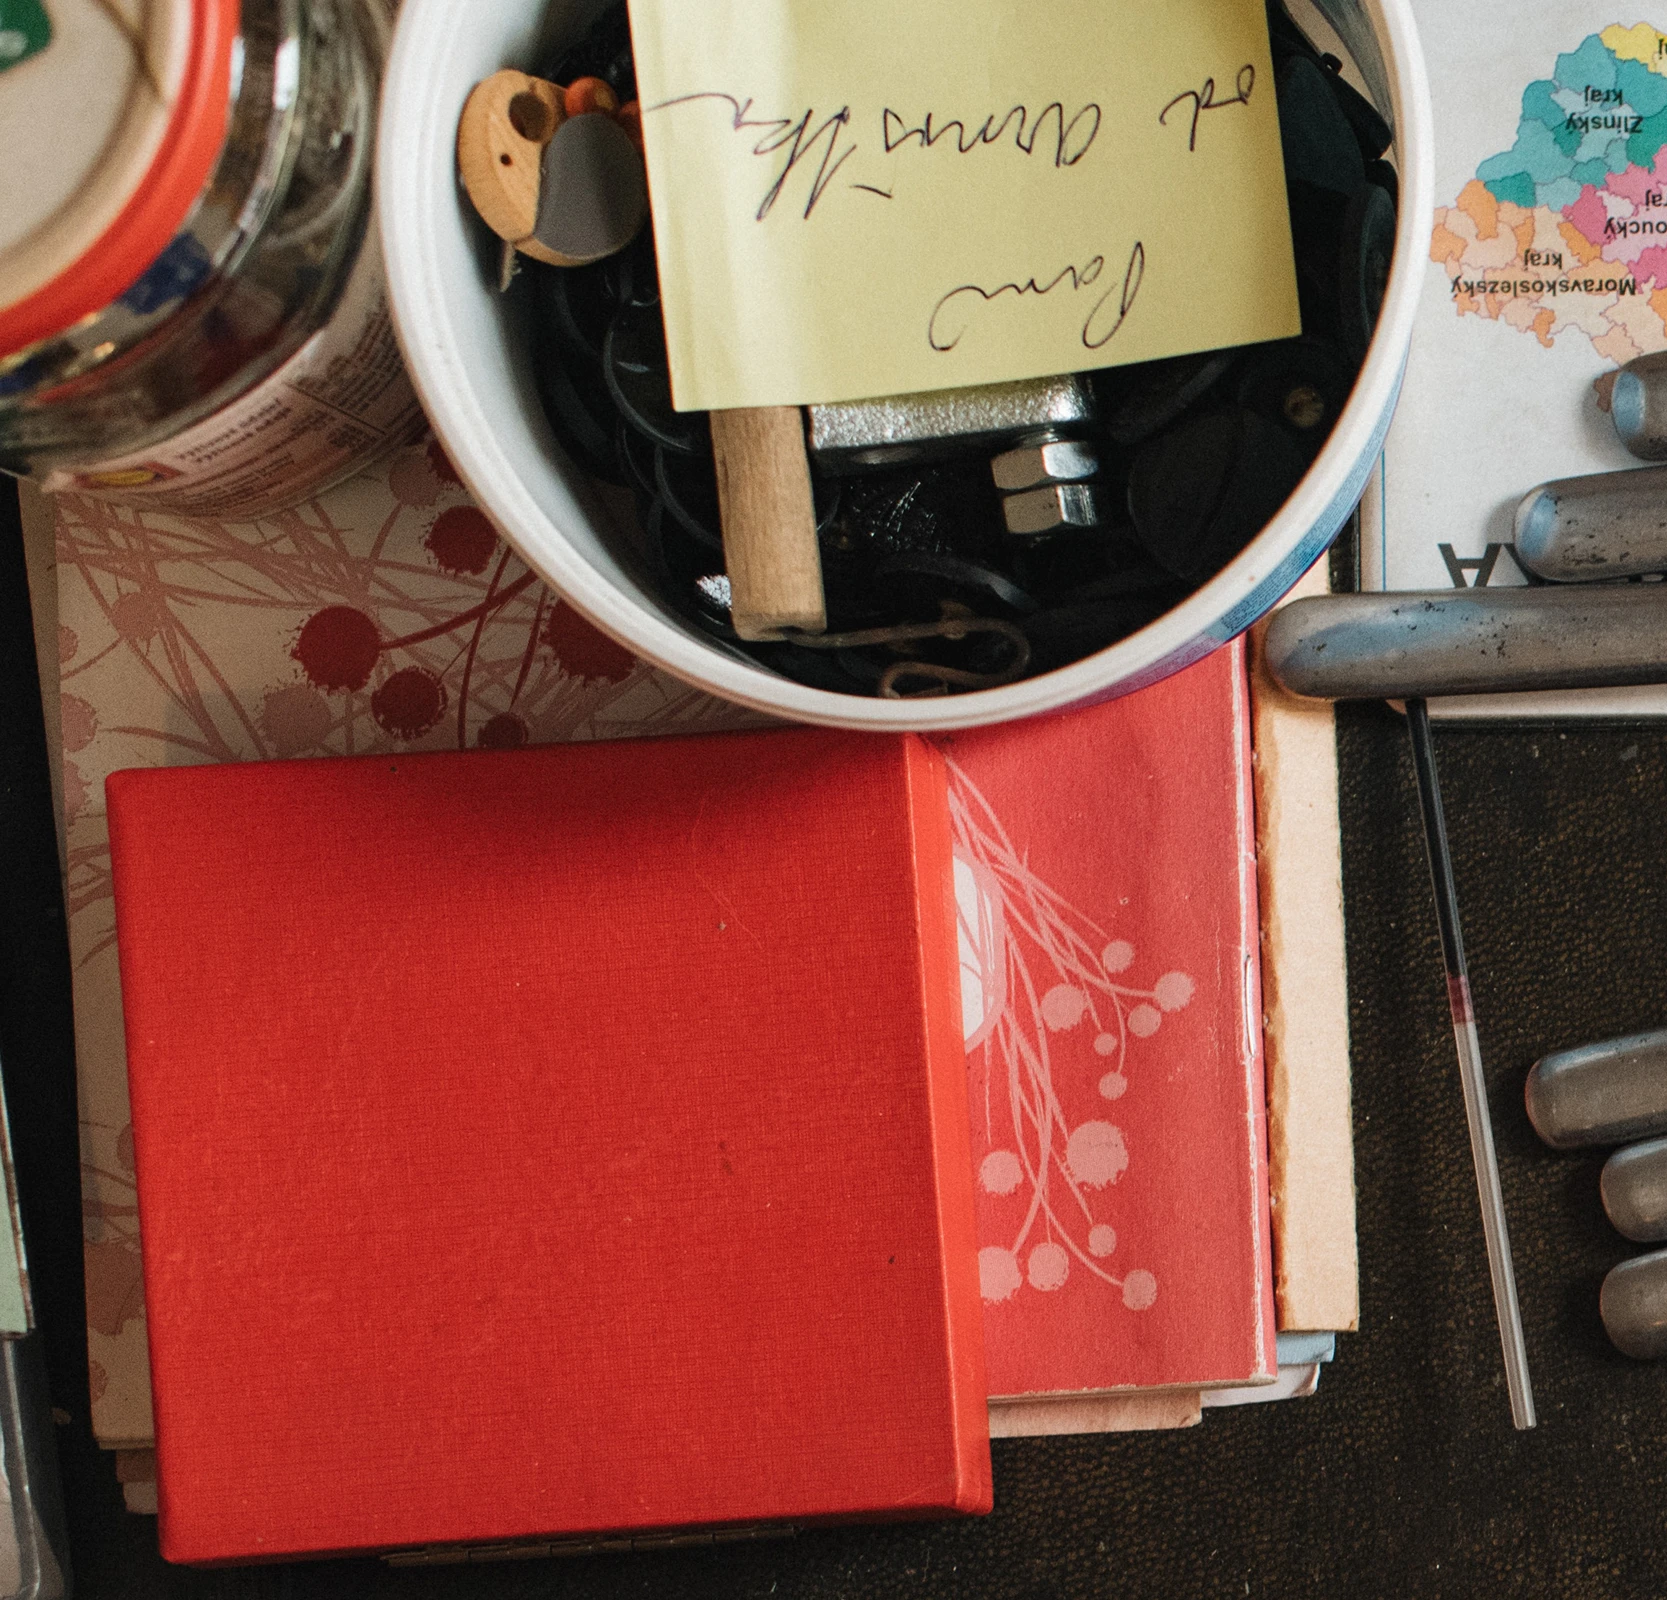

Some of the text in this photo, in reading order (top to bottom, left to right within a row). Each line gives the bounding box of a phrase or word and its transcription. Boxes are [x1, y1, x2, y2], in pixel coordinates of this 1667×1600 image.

[1583, 84, 1623, 111] kraj
[1565, 108, 1643, 137] Zlínský
[1522, 247, 1563, 275] kraj
[1450, 269, 1637, 300] Moravskoslezský
